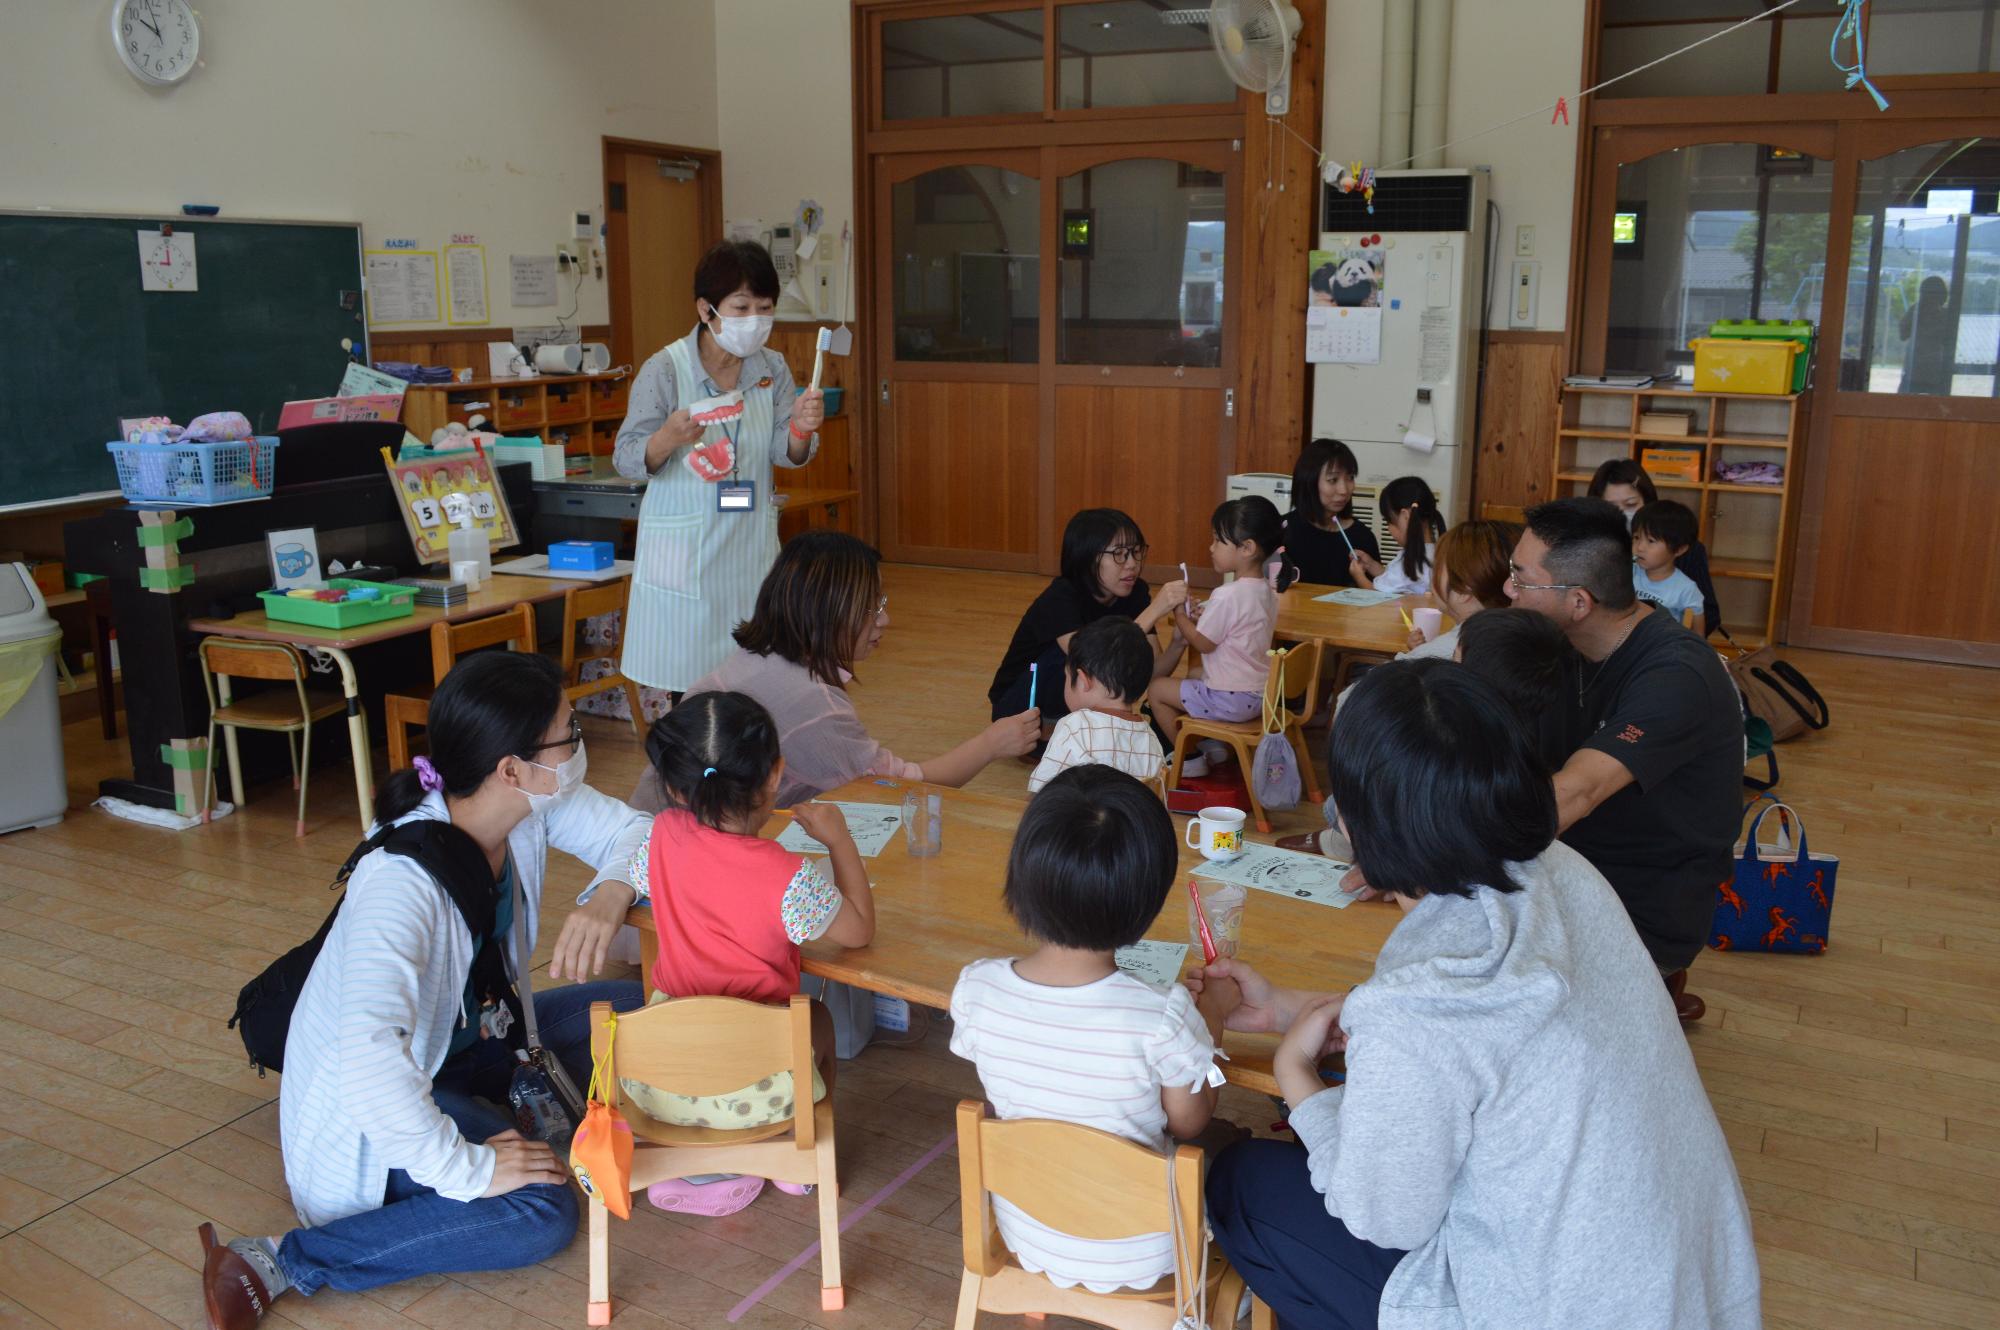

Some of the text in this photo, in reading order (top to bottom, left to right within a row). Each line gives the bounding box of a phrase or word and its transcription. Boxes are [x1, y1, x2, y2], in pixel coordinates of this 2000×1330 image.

[129, 7, 140, 20] 10
[177, 14, 184, 27] 2
[124, 23, 133, 36] 9
[182, 31, 189, 45] 3
[131, 41, 138, 54] 8
[143, 53, 150, 67] 7
[176, 49, 184, 60] 4
[155, 60, 163, 72] 6
[168, 57, 176, 70] 5
[422, 507, 433, 520] 5
